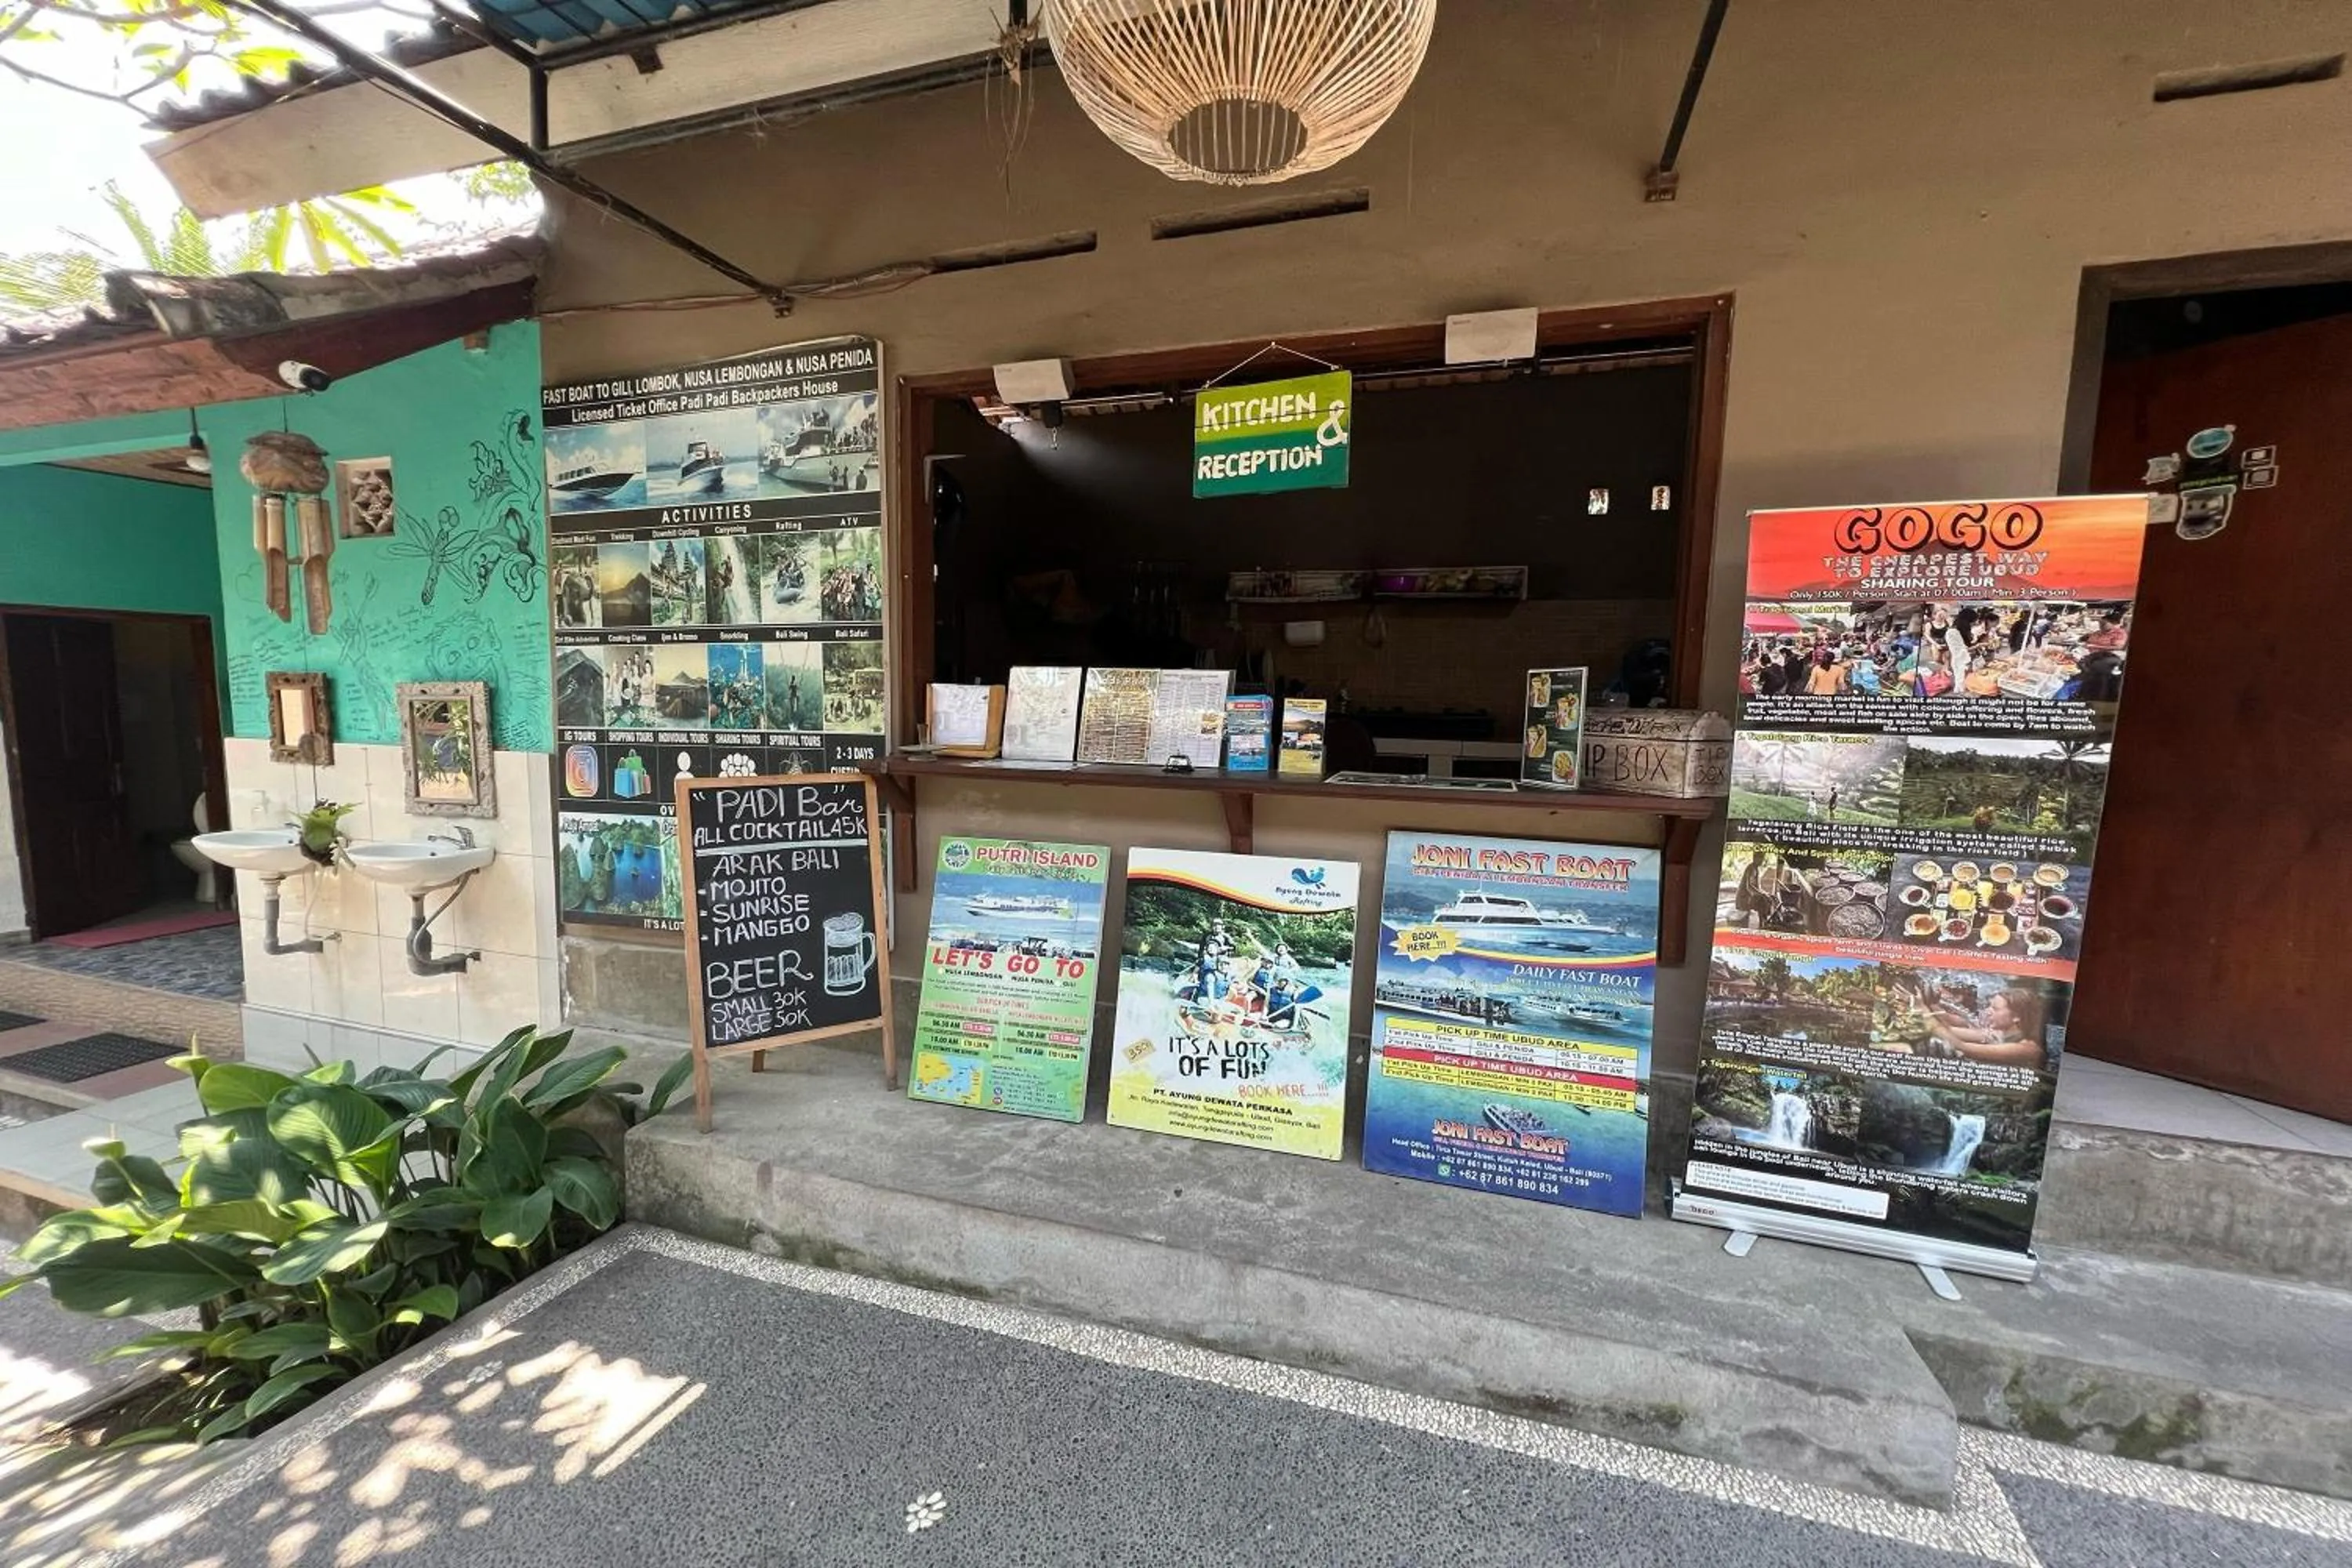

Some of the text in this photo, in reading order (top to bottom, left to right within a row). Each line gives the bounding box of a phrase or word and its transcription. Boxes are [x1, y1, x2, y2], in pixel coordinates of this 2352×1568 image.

[543, 388, 566, 405] FAST
[569, 385, 593, 402] BOAT
[596, 383, 609, 397] TO
[636, 372, 681, 394] LOMBOK,
[685, 369, 713, 387] NUSA
[715, 360, 783, 383] LEMBONGAN
[785, 359, 793, 375] &
[796, 354, 828, 374] NUSA
[830, 348, 873, 369] PENIDA
[572, 380, 838, 423] Licensed Ticket Office Padi Padi Backpackers House
[1203, 392, 1348, 447] KITCHEN &
[1197, 444, 1323, 480] RECEPTION
[662, 504, 752, 524] ACTIVITIES
[775, 521, 802, 531] Rafting
[840, 517, 858, 527] ATV
[1834, 503, 2043, 554] GOGO
[1823, 551, 2048, 568] THE CHEAPEST WAY
[1833, 564, 2039, 578] TO EXPLORE UBUD
[1790, 587, 2070, 601] Only Start at Person
[1860, 576, 1995, 589] SHARING TOUR
[715, 733, 761, 744] SHARING TOURS
[769, 735, 821, 746] SPIRITUAL TOURS
[854, 746, 874, 760] DAYS
[1584, 742, 1669, 782] IP BOX
[694, 816, 868, 847] ALL COCKTAIL 45K
[1986, 833, 2038, 844] beautiful
[976, 846, 1099, 868] PUTRI ISLAND
[1998, 841, 2034, 851] called
[712, 848, 840, 877] ARAK BALI
[1412, 844, 1471, 869] JONI
[1478, 849, 1550, 874] FAST
[1555, 854, 1636, 881] BOAT
[710, 877, 786, 901] MOJITO
[711, 894, 810, 924] SUNRISE
[644, 919, 667, 930] IT'S A
[713, 915, 810, 946] MANGGO
[1411, 931, 1439, 942] BOOK
[706, 949, 815, 1000] BEER
[931, 946, 1086, 979] LET'S GO TO
[1513, 964, 1642, 988] DAILY FAST BOAT
[711, 987, 807, 1024] SMALL 30K
[712, 1009, 813, 1040] LARGE 50K
[1169, 1036, 1270, 1059] IT'S A LOTS
[1436, 1025, 1462, 1035] PICK
[1483, 1032, 1509, 1040] TIME
[1512, 1034, 1545, 1045] UBUD
[1547, 1040, 1581, 1051] AREA
[1179, 1054, 1267, 1080] OF FUN
[1434, 1054, 1461, 1065] PICK
[1482, 1062, 1506, 1072] TIME
[1509, 1067, 1543, 1077] UBUD
[1544, 1071, 1579, 1083] AREA
[1434, 1065, 1453, 1073] Time
[1461, 1069, 1509, 1081] LEMBONGAN
[1238, 1084, 1274, 1098] BOOK
[1403, 1070, 1420, 1079] Pick
[1436, 1075, 1454, 1083] Time
[1461, 1079, 1509, 1091] LEMBONGAN
[1153, 1087, 1294, 1116] PT. AYUNG DEWATA PERKASA
[1432, 1119, 1468, 1140] JONI
[1473, 1124, 1516, 1147] FAST
[1520, 1131, 1570, 1155] BOAT
[1392, 1138, 1585, 1175] Head Office Ubud Bali
[1410, 1149, 1436, 1160] Mobile
[1441, 1155, 1454, 1164] +62
[1515, 1167, 1530, 1177] +62
[1459, 1169, 1478, 1180] +62
[1495, 1175, 1514, 1186] 861
[1517, 1179, 1536, 1191] 890
[1539, 1182, 1559, 1195] 834
[1999, 1193, 2027, 1205] down
